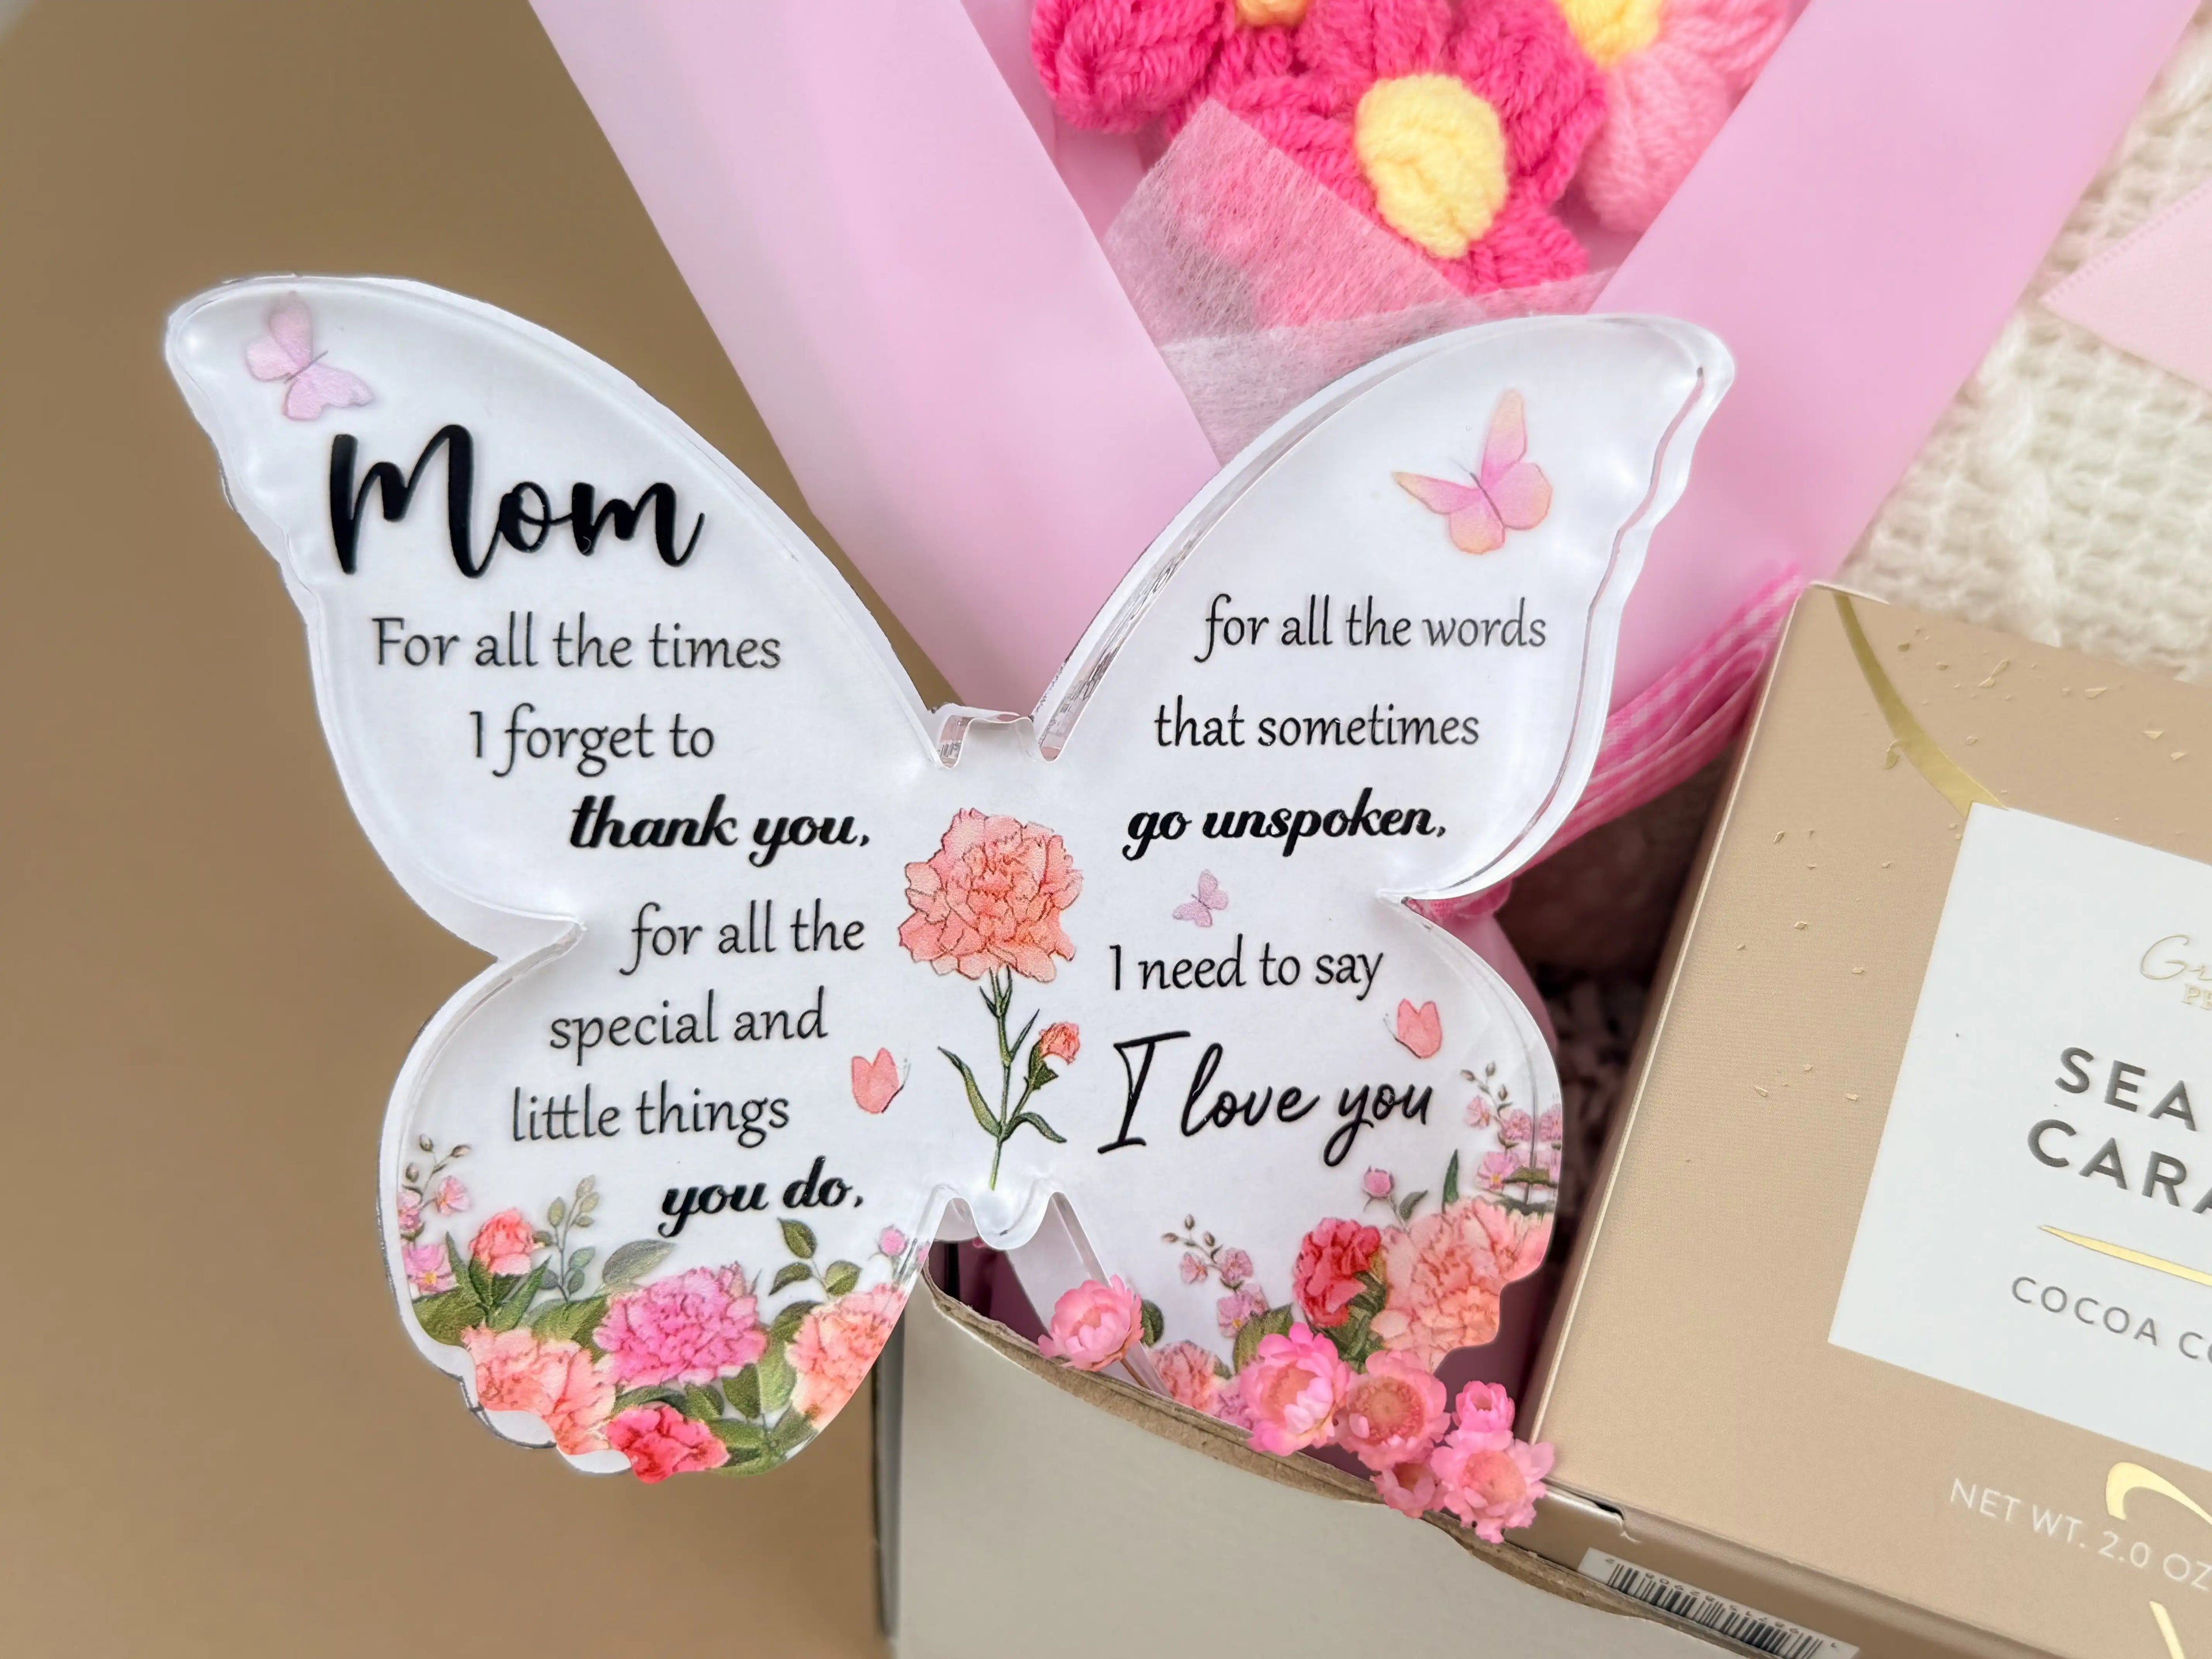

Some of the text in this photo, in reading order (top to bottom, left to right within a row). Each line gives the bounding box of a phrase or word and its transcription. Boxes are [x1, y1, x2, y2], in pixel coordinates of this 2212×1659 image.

[328, 424, 704, 579] Mom
[372, 611, 781, 669] For all the times
[1194, 593, 1547, 663] for all the words
[469, 703, 714, 778] I forget to
[1154, 695, 1479, 747] that sometimes
[569, 794, 738, 849] thank
[1122, 787, 1446, 861] go unspoken,
[619, 898, 865, 976] for all the
[1109, 933, 1384, 1001] I need to say
[550, 985, 828, 1066] special and
[513, 1080, 790, 1149] little things
[1097, 1030, 1433, 1168] I love you
[2054, 1047, 2197, 1132] SEA
[657, 1183, 769, 1238] you
[2012, 1277, 2157, 1346] COCOA
[1950, 1478, 2021, 1522] NET
[2032, 1504, 2086, 1548] WT.
[2097, 1531, 2150, 1568] 2.0
